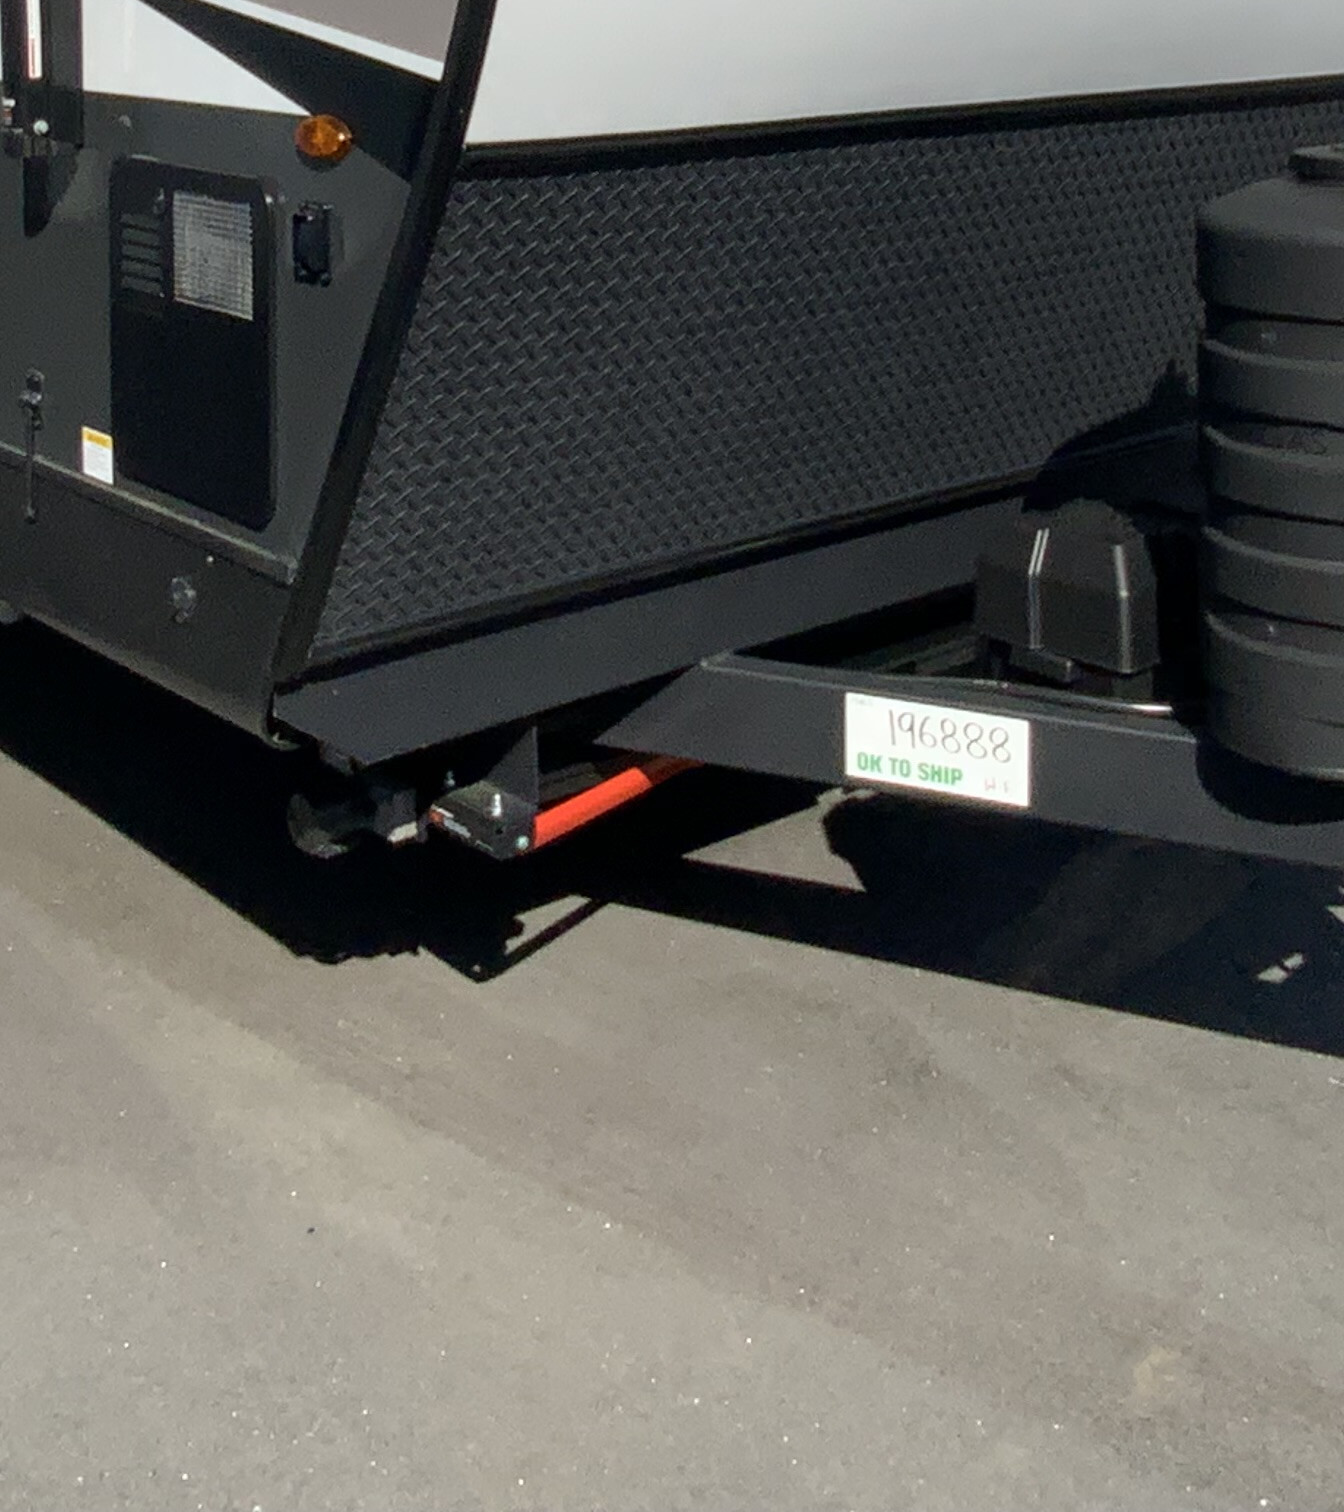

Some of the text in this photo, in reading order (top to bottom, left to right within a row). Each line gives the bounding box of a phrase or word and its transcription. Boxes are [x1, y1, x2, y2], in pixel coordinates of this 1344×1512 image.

[888, 709, 1012, 764] 196888
[856, 751, 883, 773] OK
[889, 756, 911, 777] TO
[917, 762, 963, 786] SHIP
